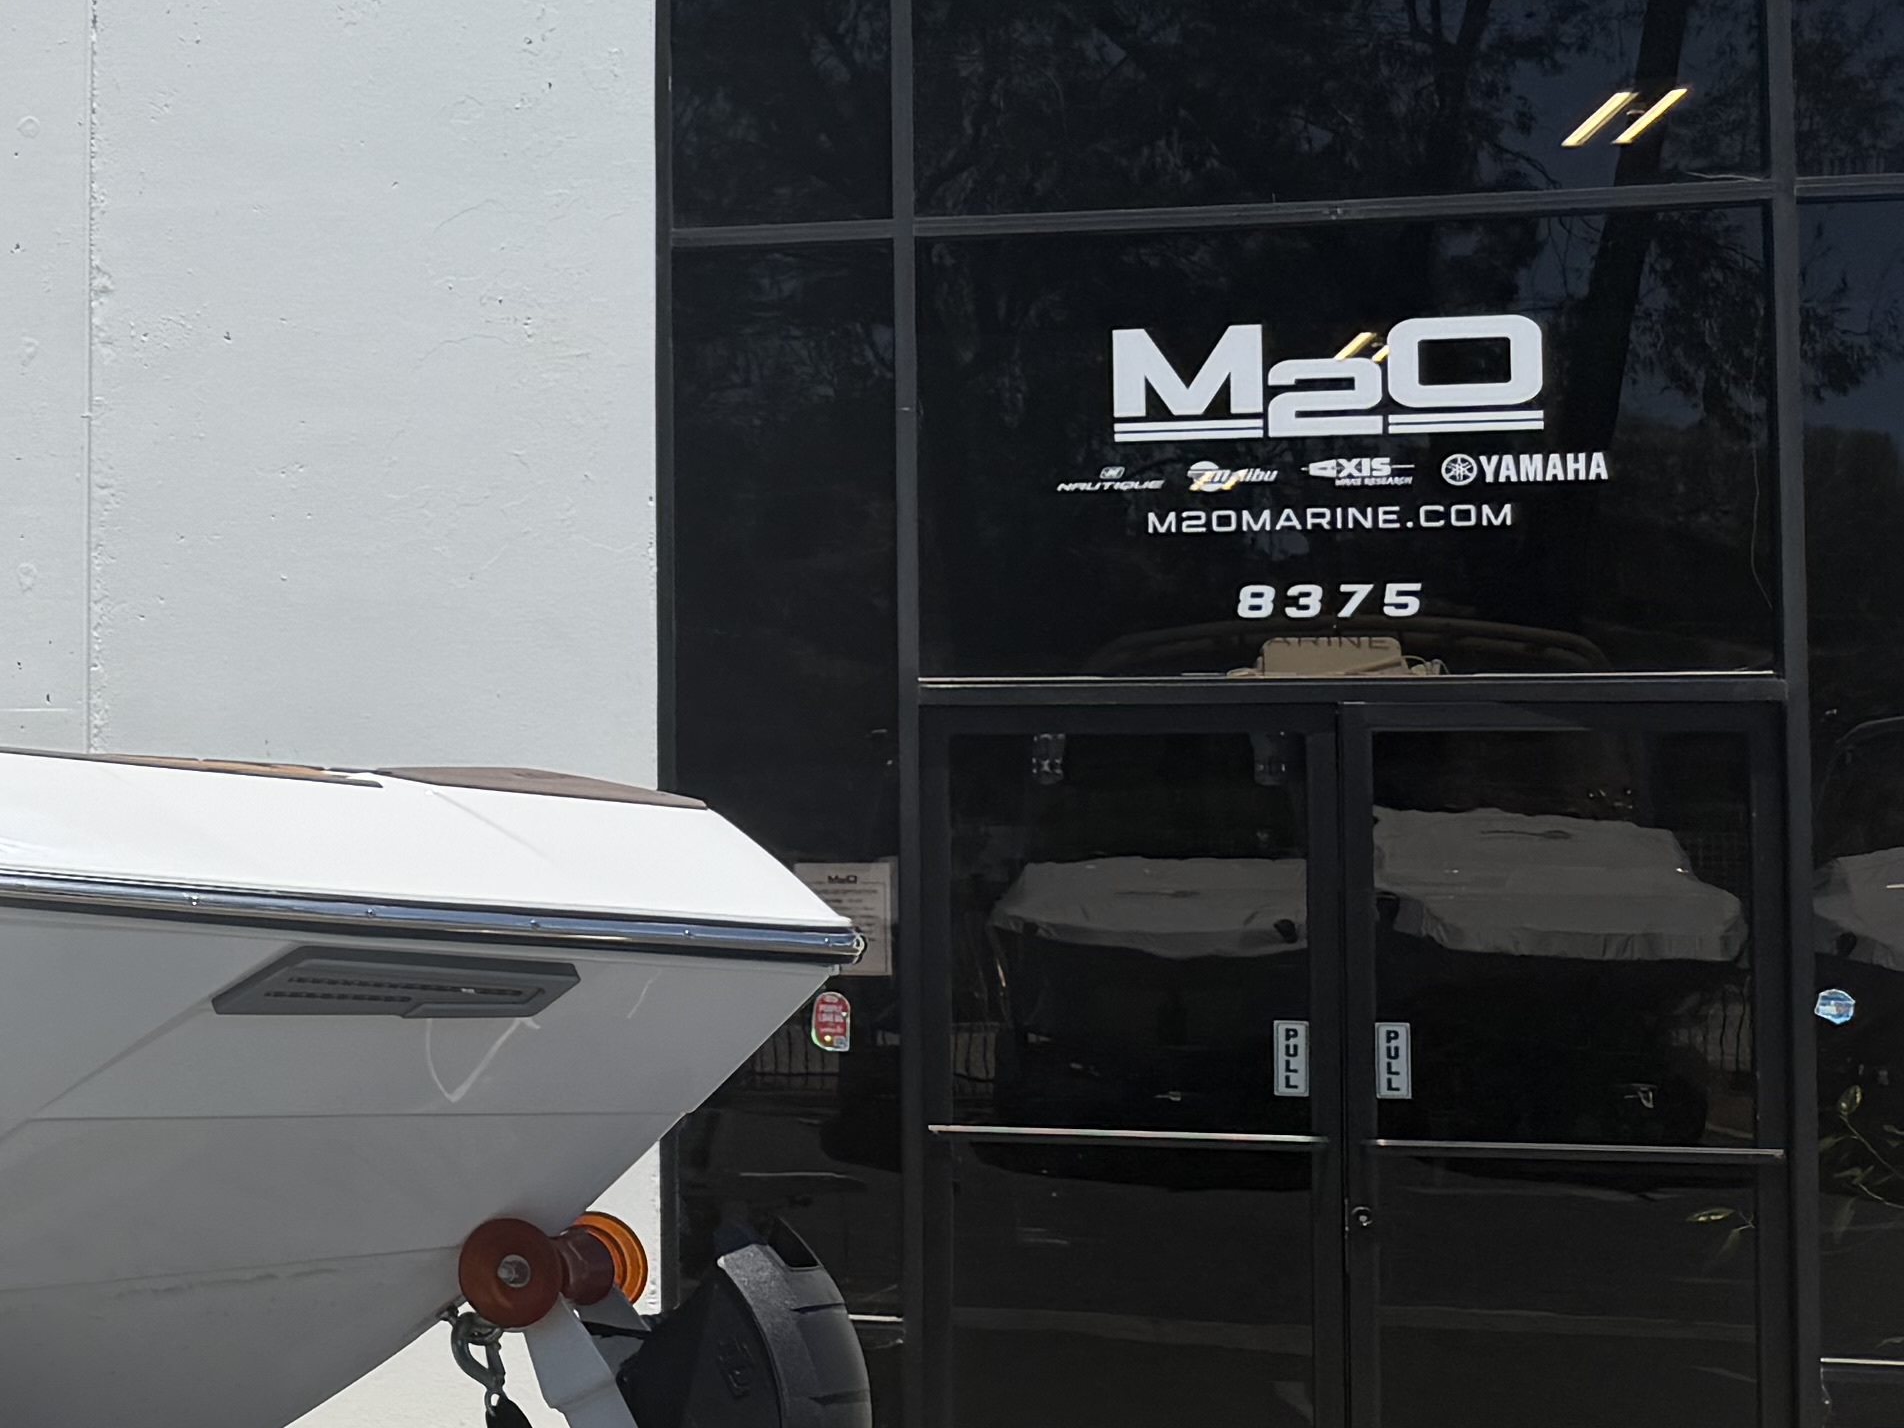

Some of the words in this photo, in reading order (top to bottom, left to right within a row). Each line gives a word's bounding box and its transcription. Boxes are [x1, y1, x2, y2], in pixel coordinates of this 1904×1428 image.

[1056, 479, 1165, 492] NAUTIQUE
[1481, 451, 1609, 484] YAMAHA
[1237, 582, 1423, 619] 8375
[1284, 1027, 1299, 1090] PULL
[1385, 1029, 1401, 1092] PULL
